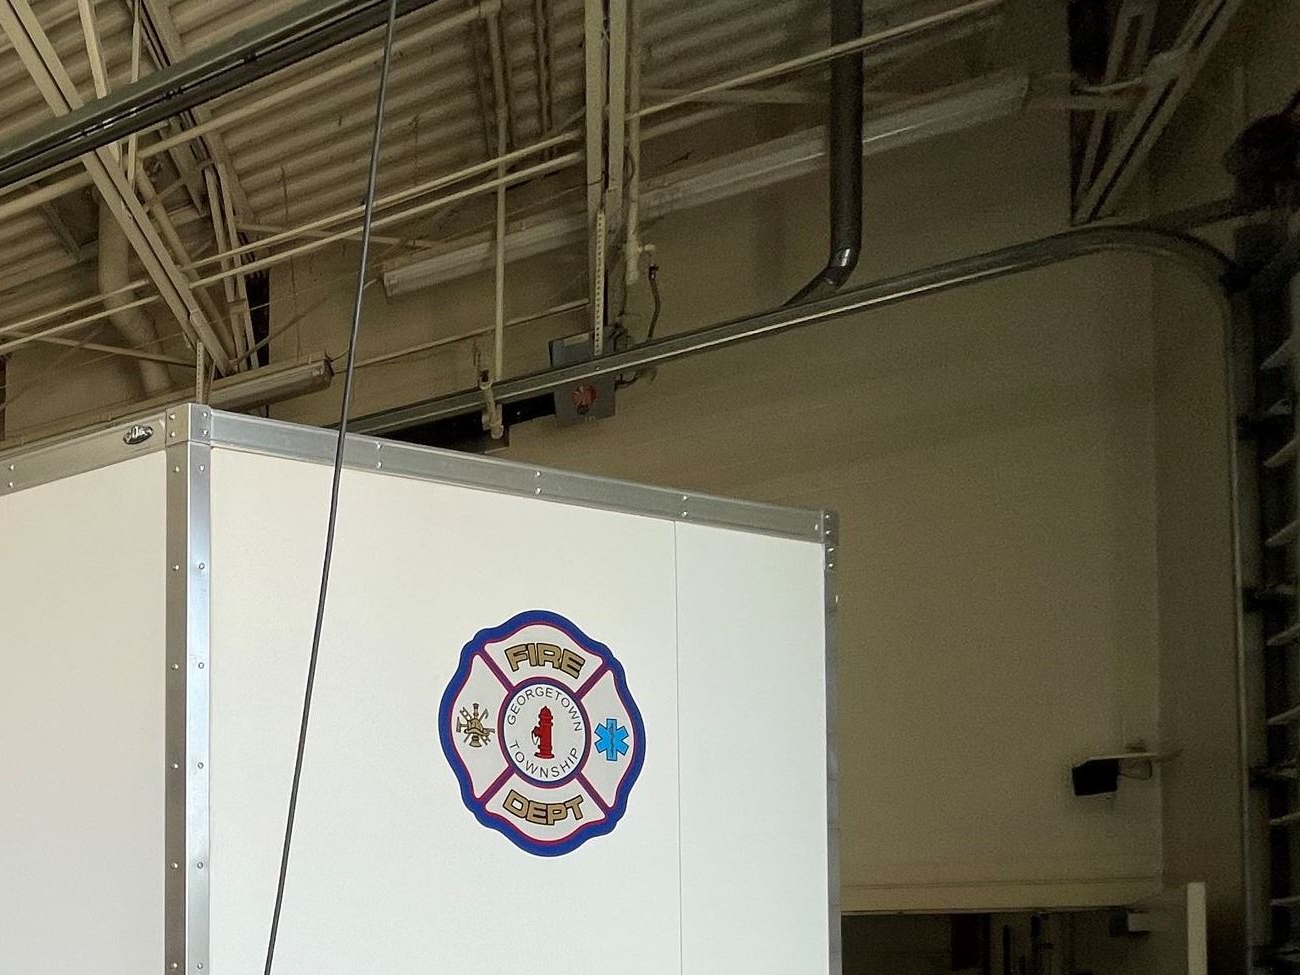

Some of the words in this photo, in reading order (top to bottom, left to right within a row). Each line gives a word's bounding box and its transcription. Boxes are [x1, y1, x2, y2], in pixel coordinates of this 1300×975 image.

[504, 642, 586, 680] FIRE
[507, 686, 582, 732] GEORGETOWN
[509, 741, 579, 779] TOWNSHIP
[502, 789, 584, 825] DEPT
